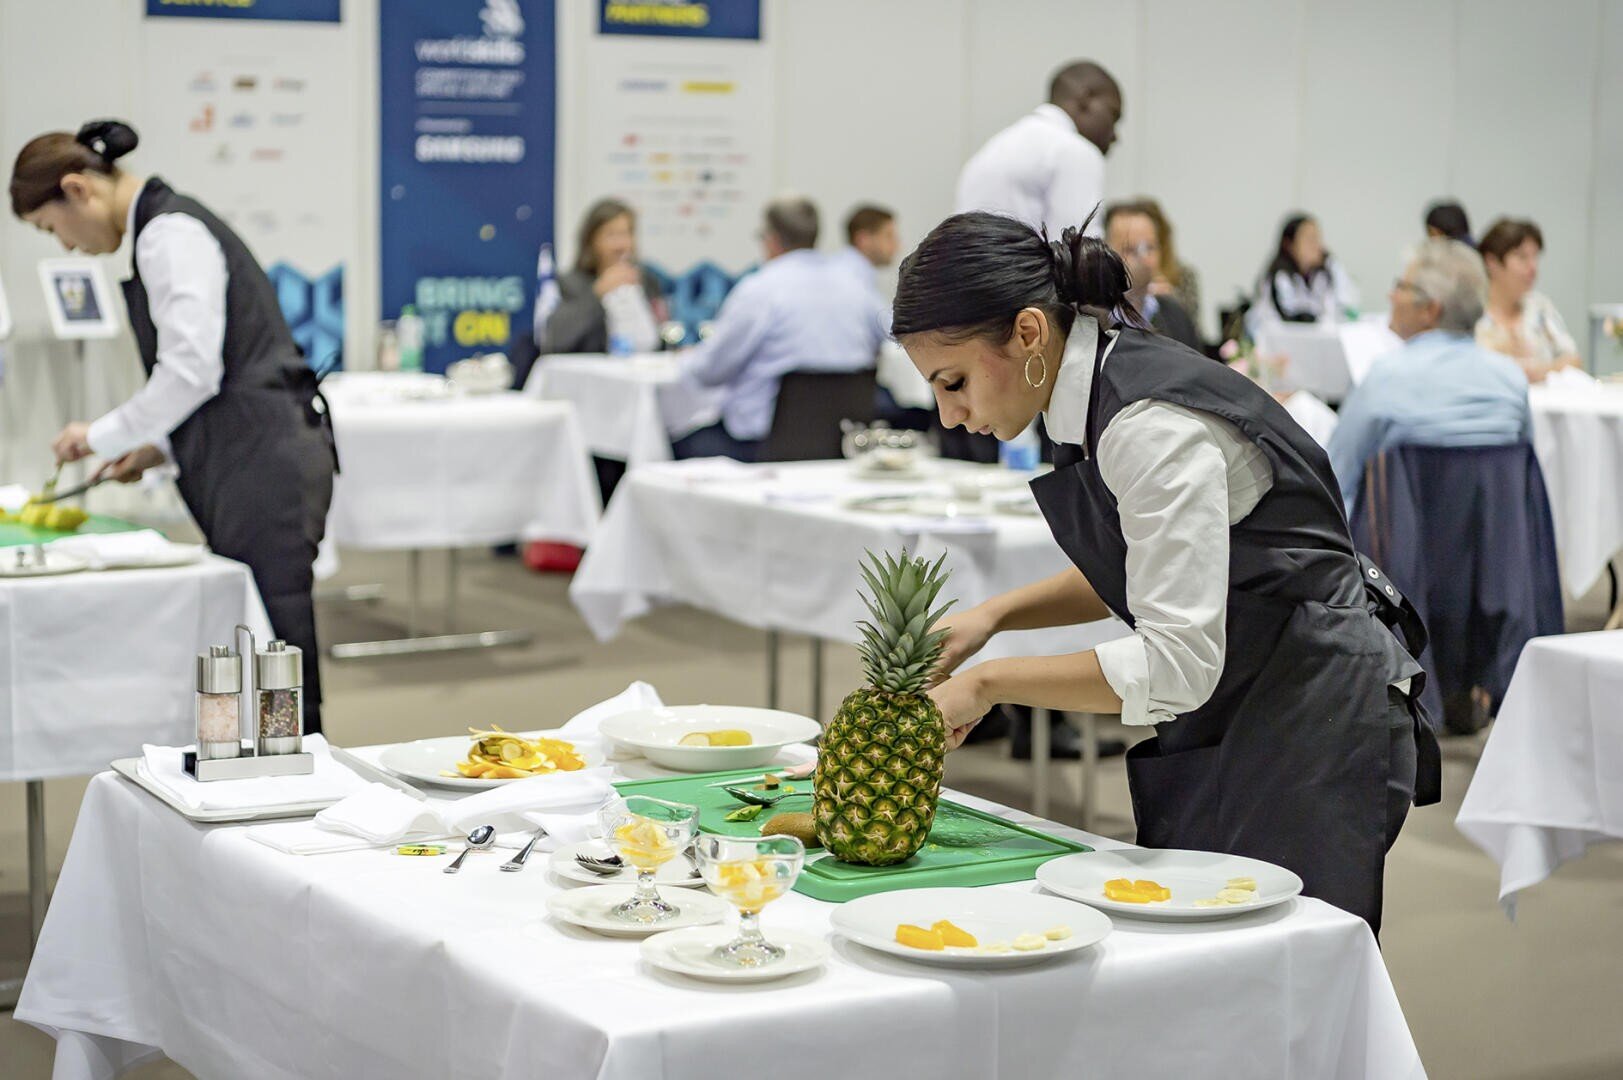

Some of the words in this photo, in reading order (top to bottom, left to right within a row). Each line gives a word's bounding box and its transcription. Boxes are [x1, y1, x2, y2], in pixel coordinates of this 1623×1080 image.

[415, 134, 525, 163] SAMSUNG
[416, 276, 523, 312] BRING
[453, 309, 511, 347] ON
